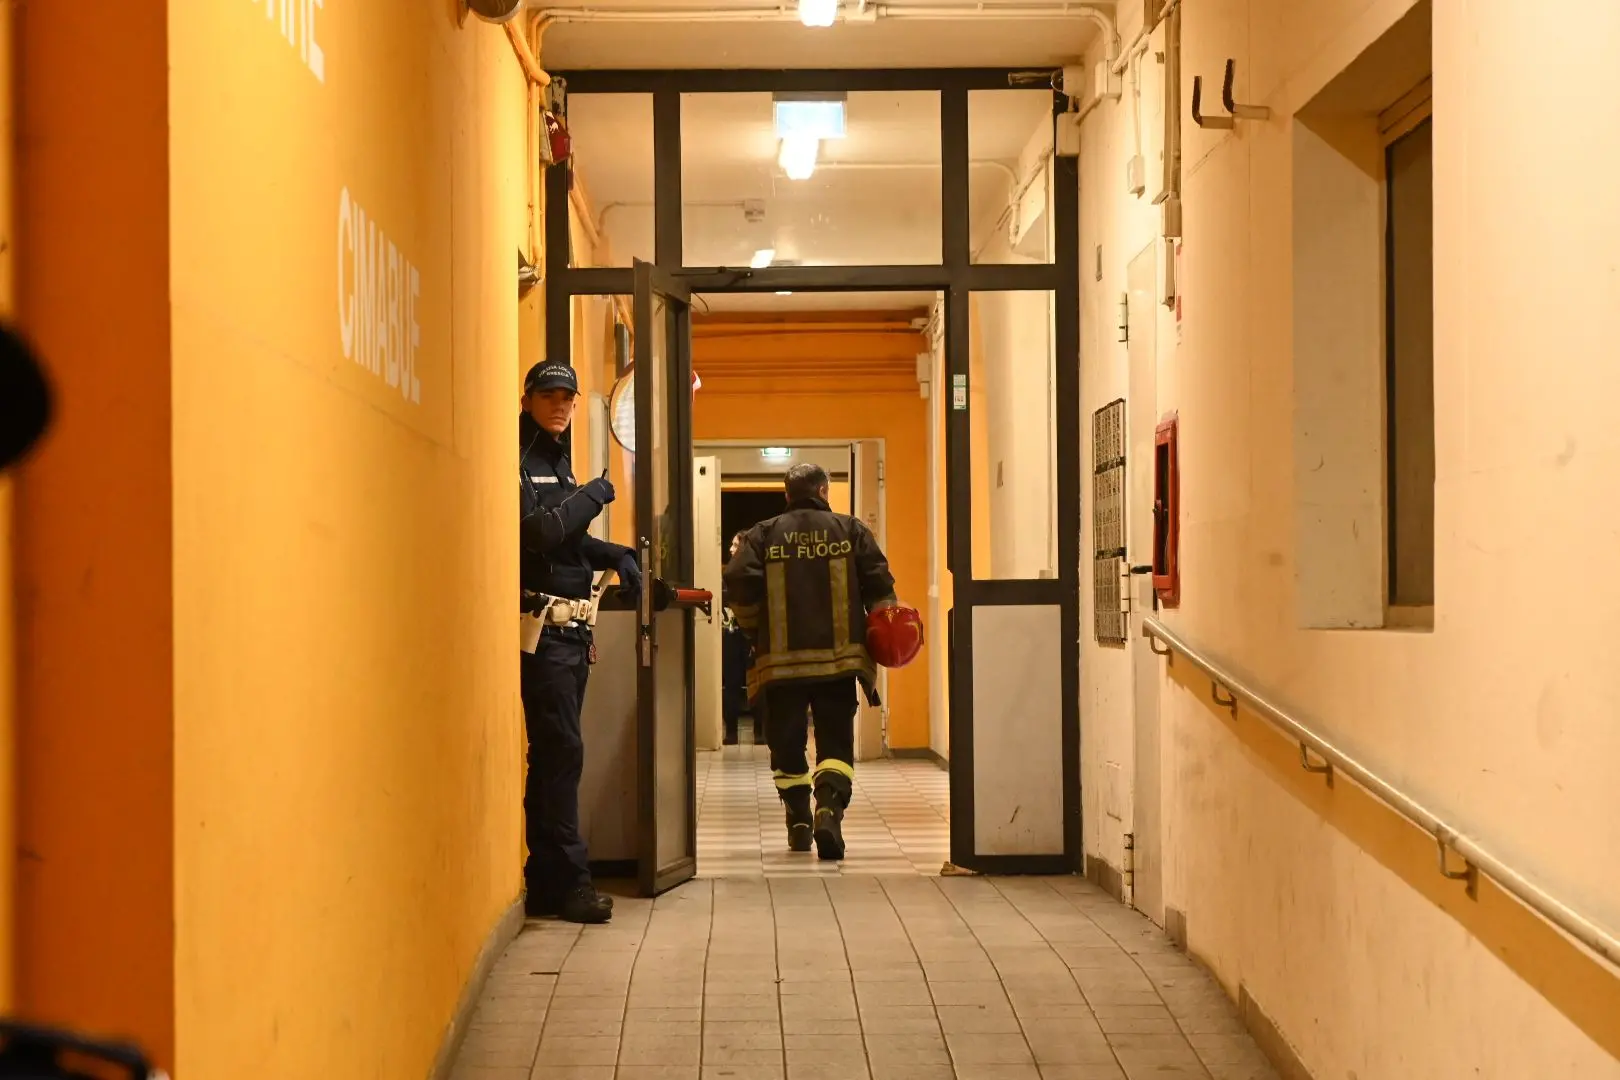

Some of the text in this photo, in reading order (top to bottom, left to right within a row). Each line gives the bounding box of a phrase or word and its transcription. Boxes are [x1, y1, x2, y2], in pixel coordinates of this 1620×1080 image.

[338, 185, 420, 405] CIMABUE
[784, 529, 828, 545] VIGILI
[797, 540, 852, 559] FUOCO
